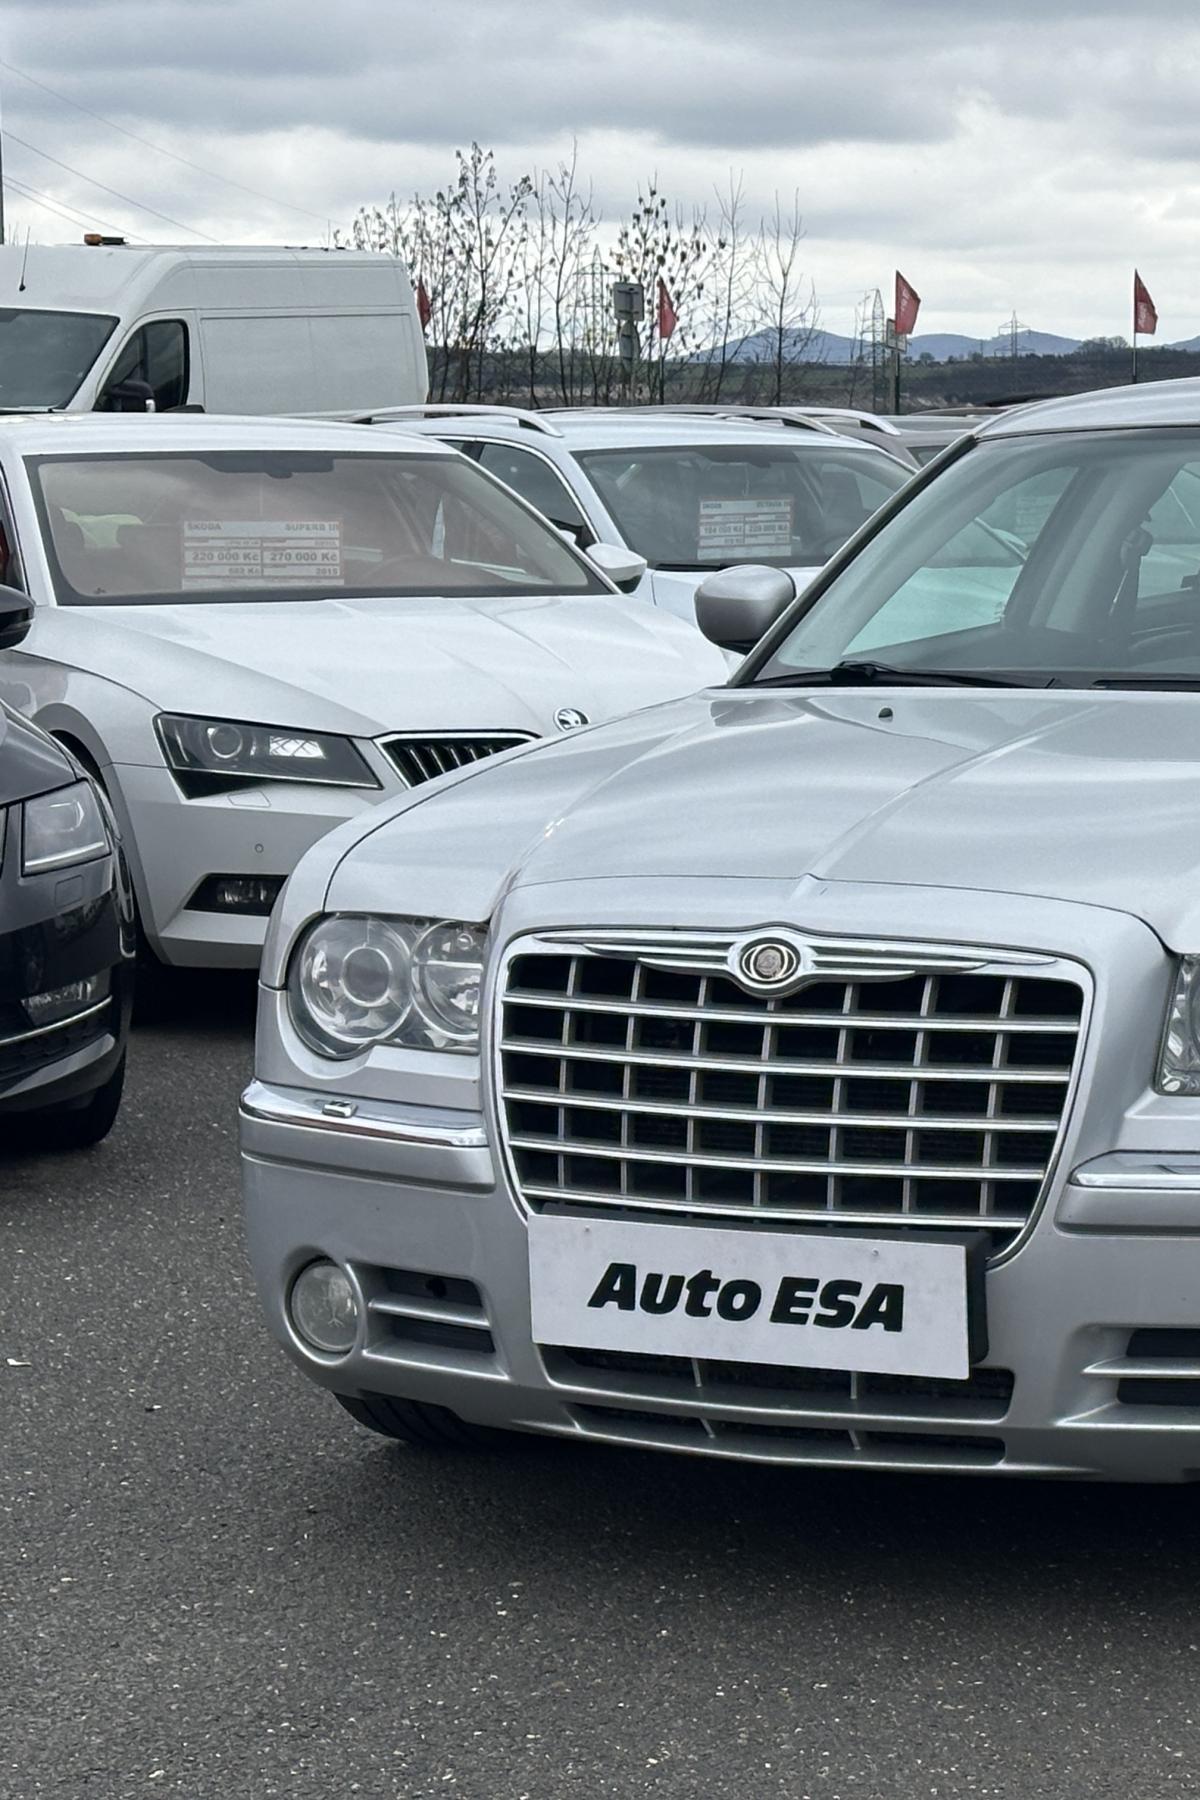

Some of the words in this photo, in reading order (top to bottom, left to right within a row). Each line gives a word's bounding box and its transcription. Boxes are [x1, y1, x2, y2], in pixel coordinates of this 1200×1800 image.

[192, 552, 214, 561] 220
[217, 552, 239, 561] 000
[270, 552, 292, 561] 270
[295, 551, 317, 561] 000
[587, 1262, 762, 1321] Auto
[769, 1277, 904, 1332] ESA
